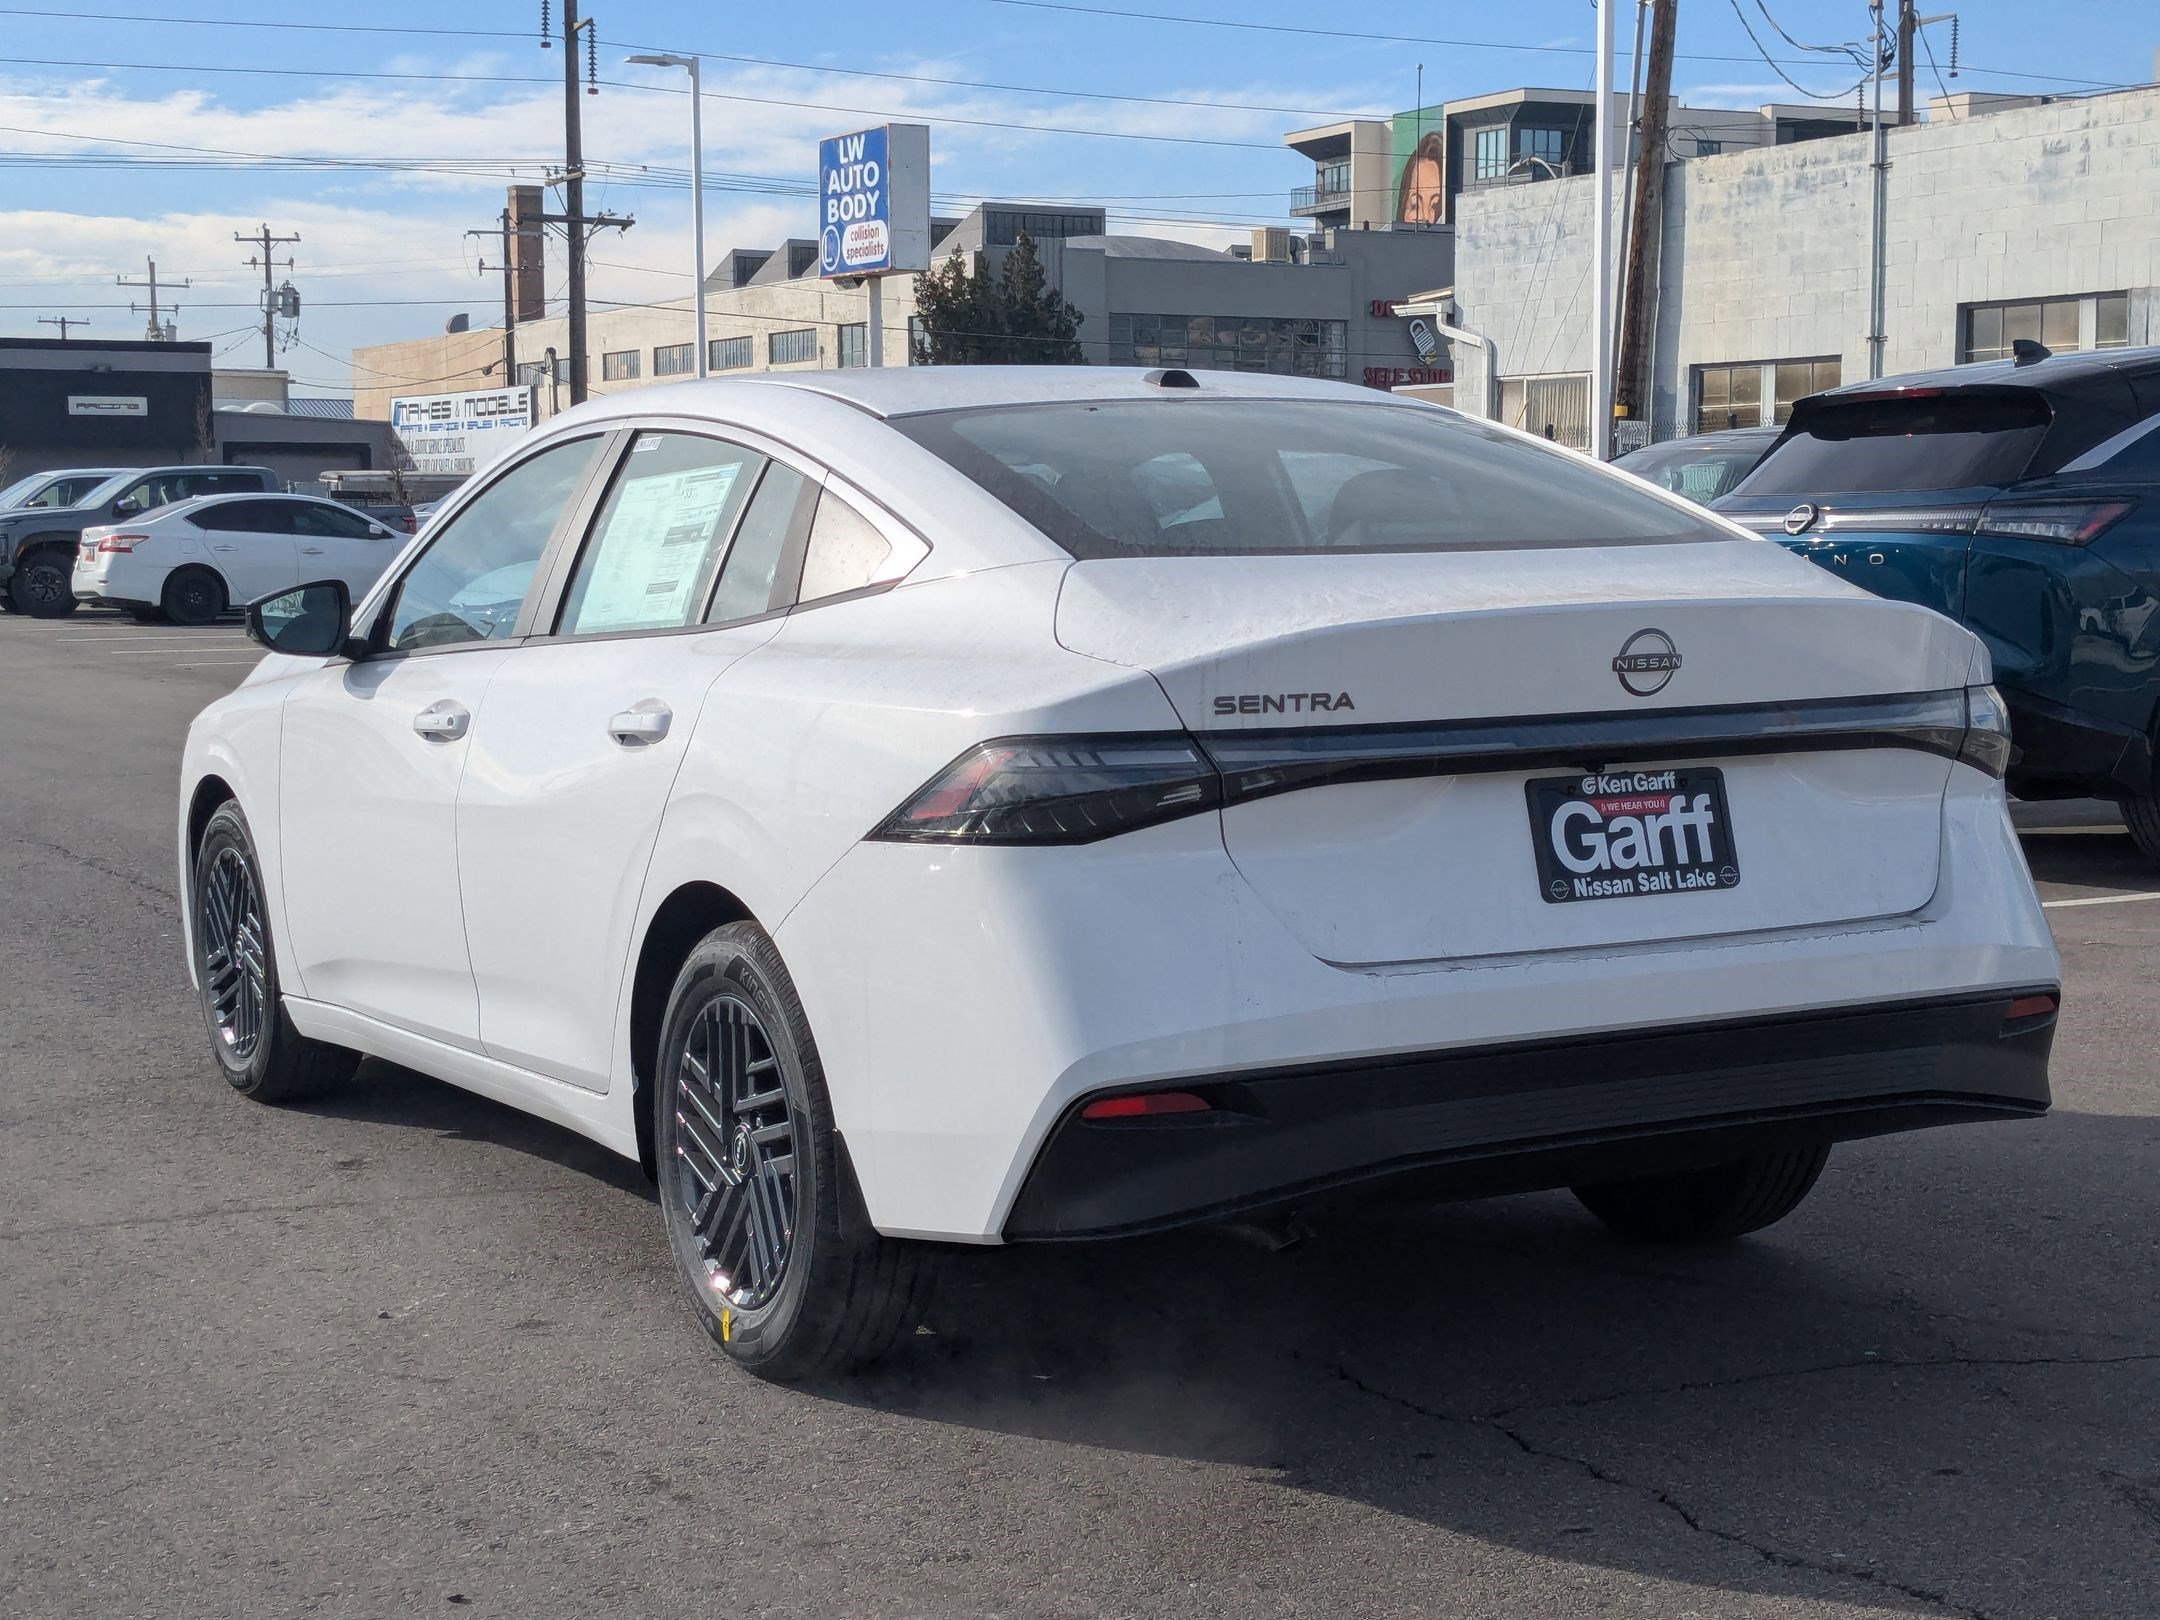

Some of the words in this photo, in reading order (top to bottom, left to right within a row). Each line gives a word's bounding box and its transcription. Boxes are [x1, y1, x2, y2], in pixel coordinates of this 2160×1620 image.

[839, 134, 865, 164] LW
[828, 161, 880, 195] AUTO
[827, 190, 880, 223] BODY
[850, 224, 880, 242] collision
[846, 241, 884, 263] specialists
[397, 400, 451, 422] MAKES
[465, 392, 528, 417] MODELS
[1616, 657, 1681, 670] NISSAN
[1214, 692, 1355, 715] SENTRA
[1598, 776, 1633, 794] Ken
[1633, 771, 1675, 791] Garff
[1606, 802, 1620, 811] WE
[1621, 801, 1642, 810] HEAR
[1643, 800, 1660, 809] YOU
[1551, 793, 1715, 874] Garff
[1573, 876, 1634, 898] Nissan
[1637, 871, 1673, 892] Salt
[1676, 868, 1716, 889] Lake
